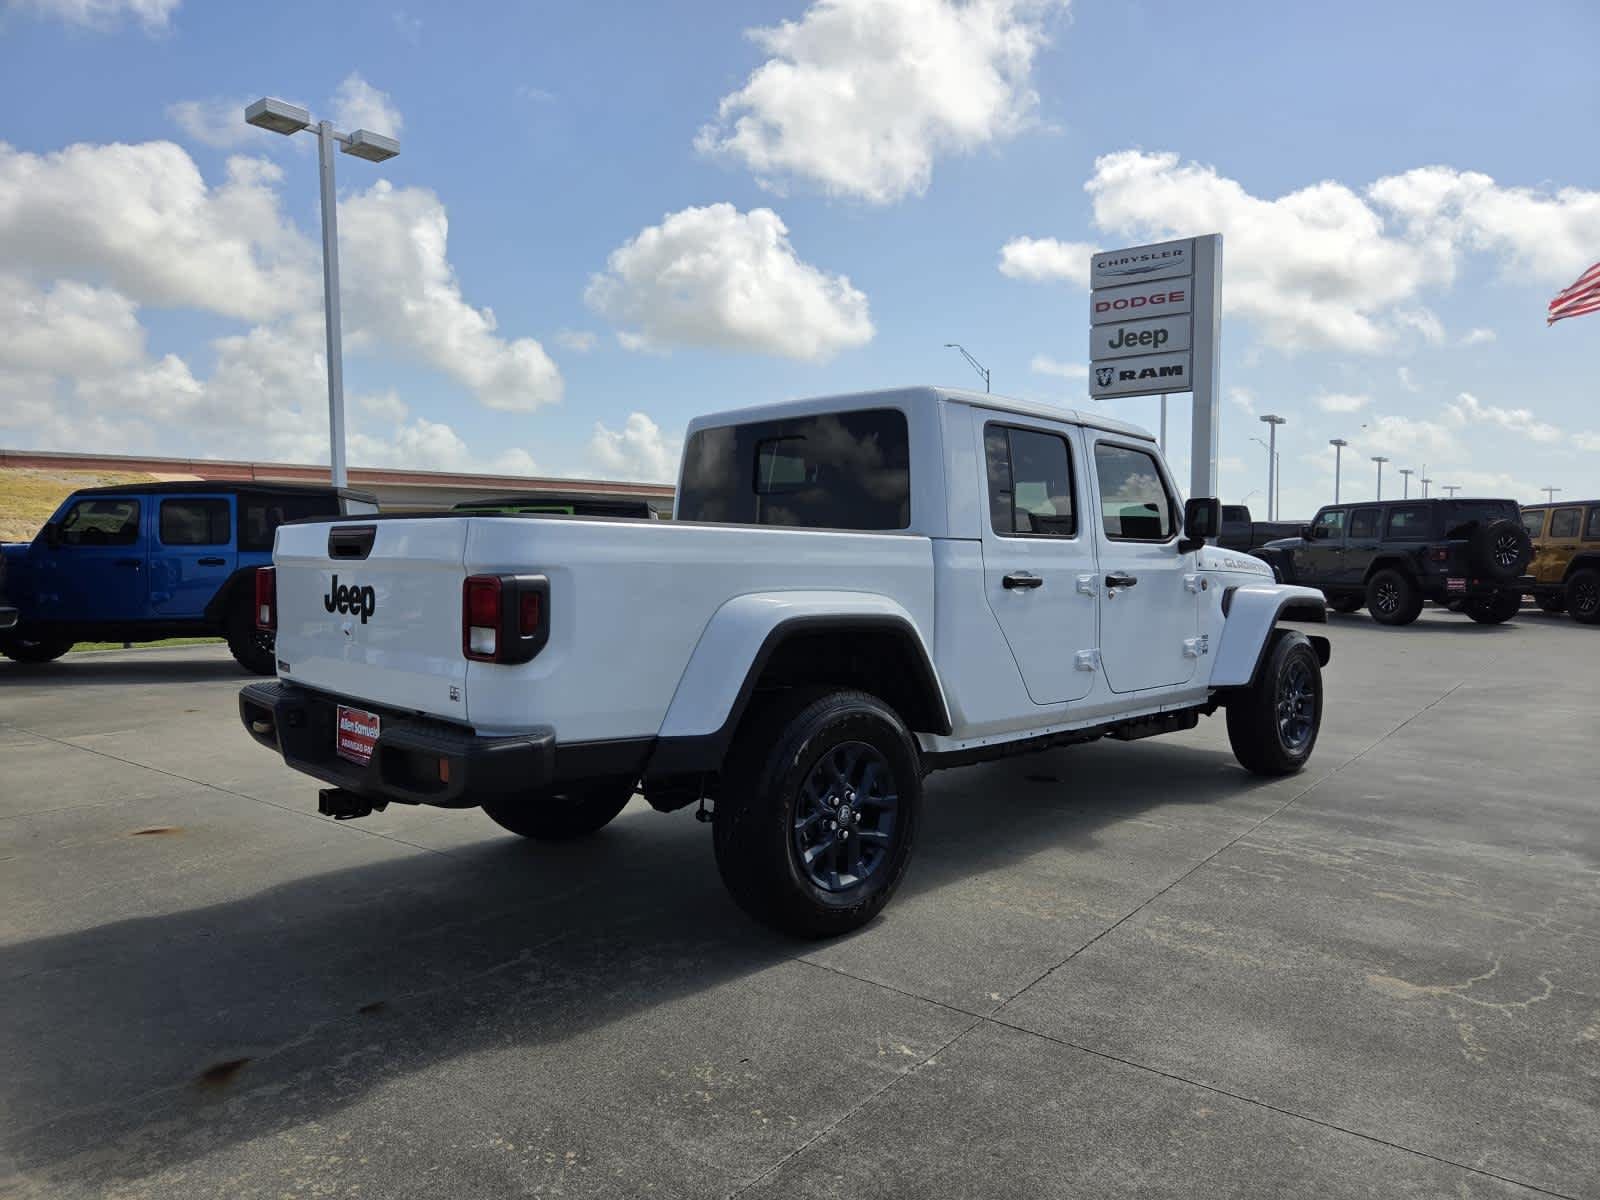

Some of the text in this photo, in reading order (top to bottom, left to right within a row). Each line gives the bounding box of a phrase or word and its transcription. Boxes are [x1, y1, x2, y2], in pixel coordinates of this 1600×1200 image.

[1097, 250, 1184, 269] CHRYSLER
[1095, 291, 1185, 313] DODGE
[1108, 328, 1169, 349] Jeep
[1119, 365, 1184, 382] RAM
[324, 574, 375, 625] Jeep
